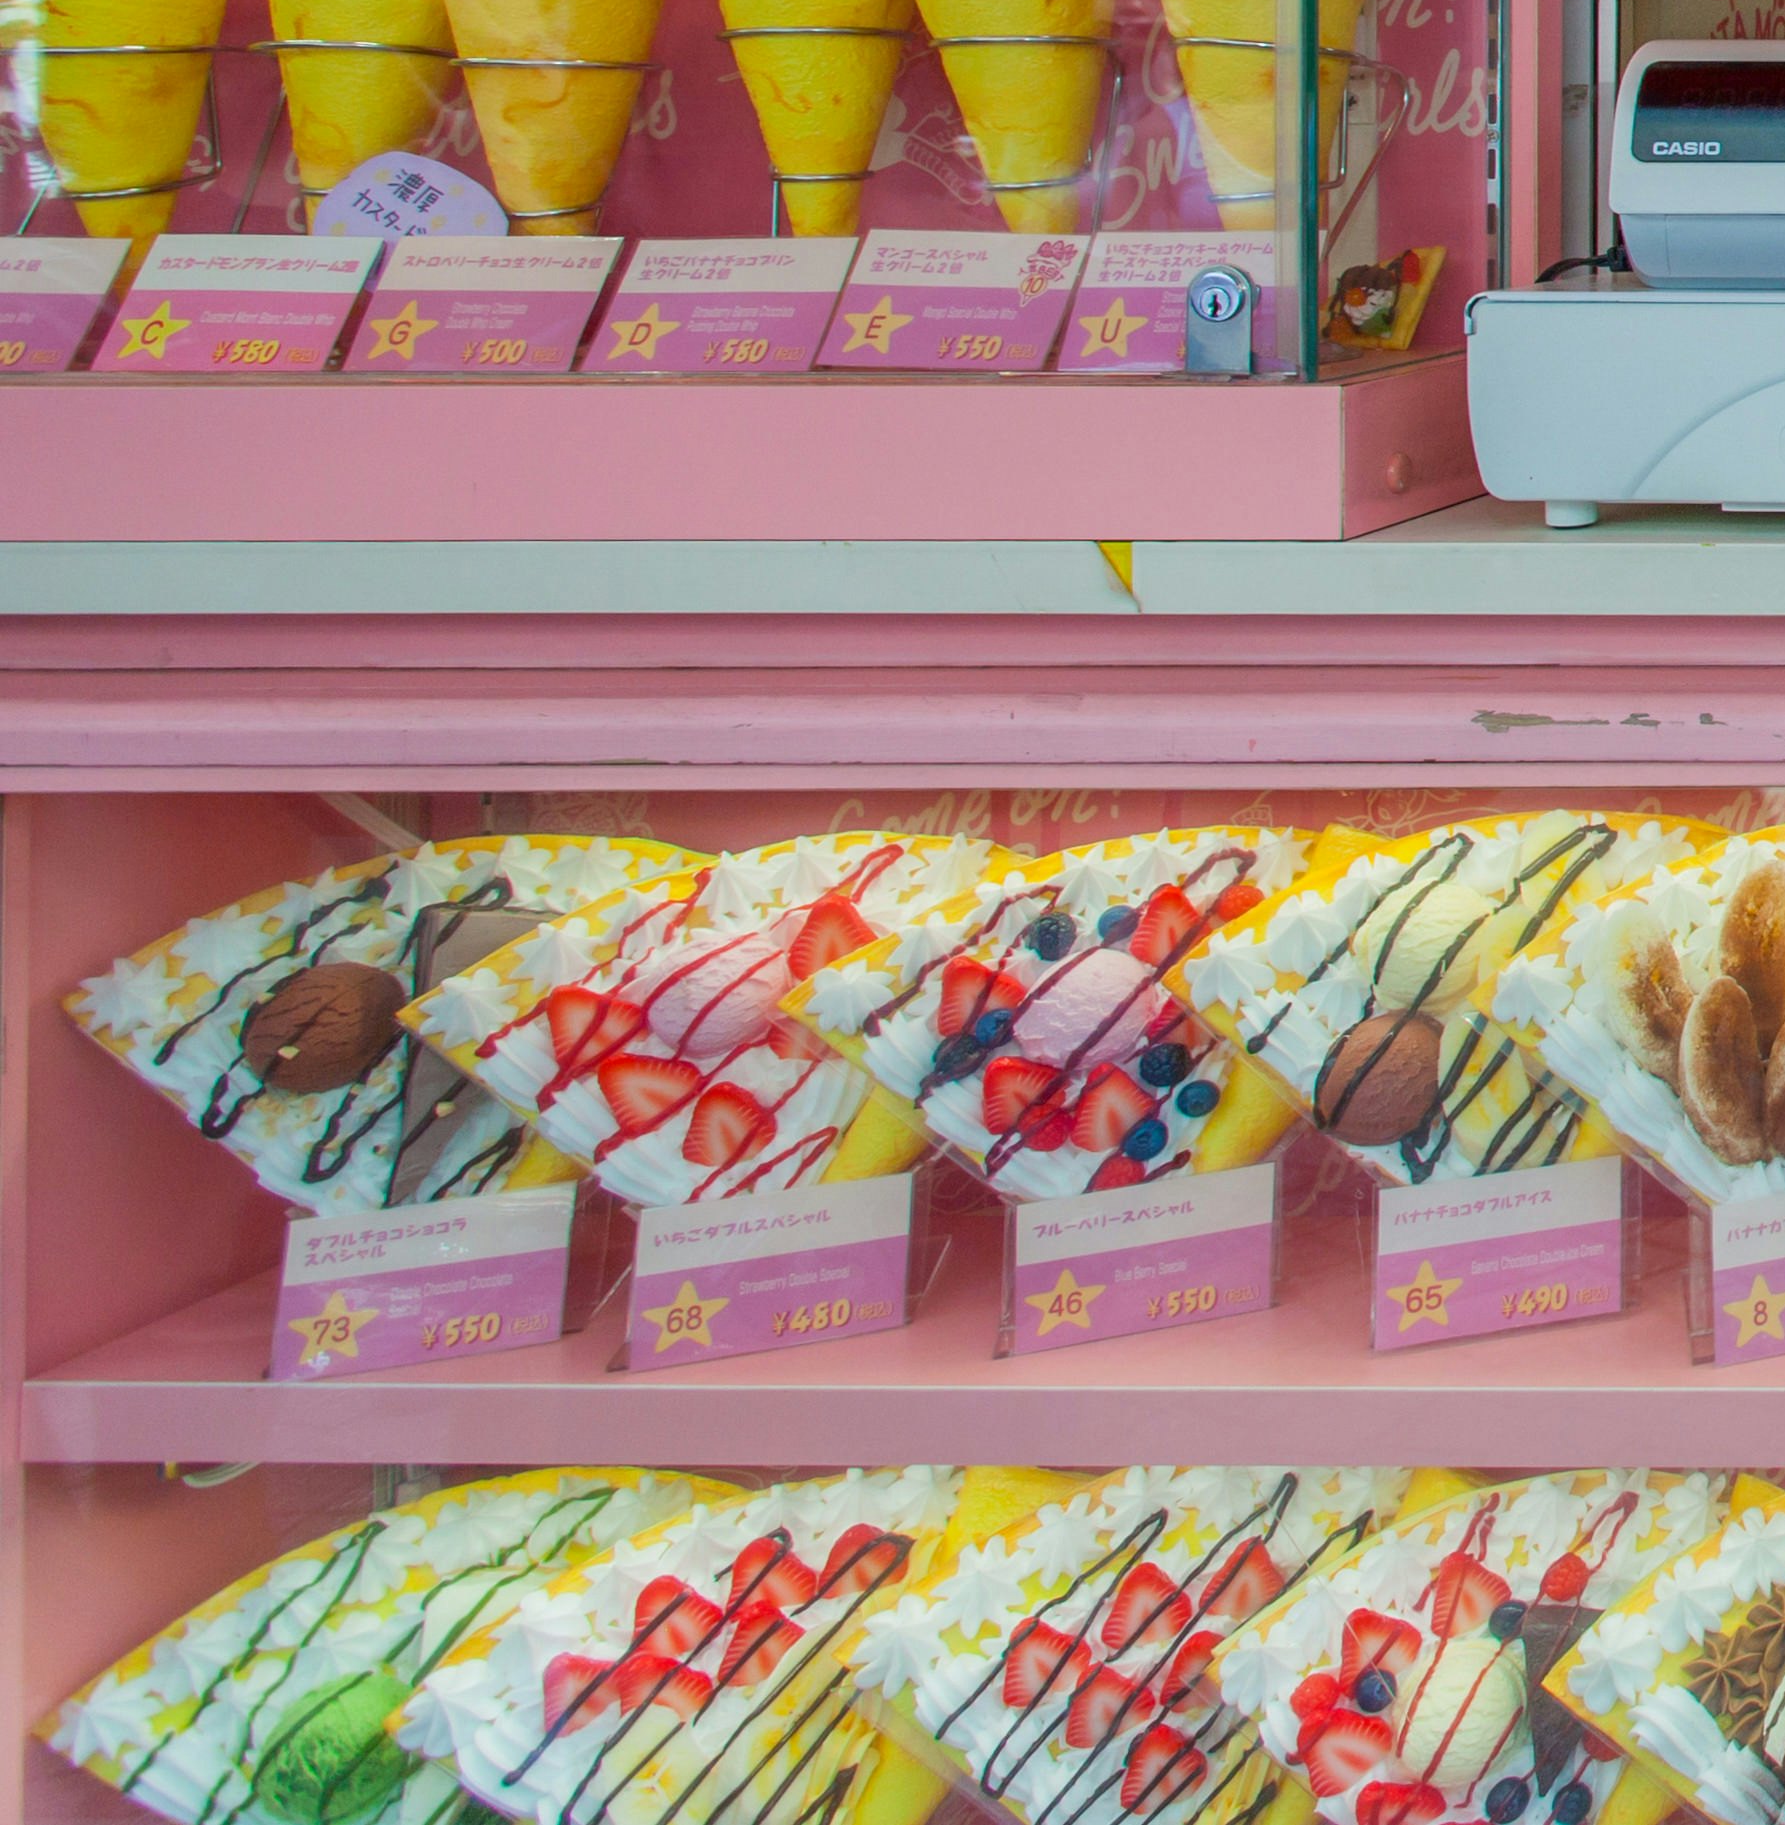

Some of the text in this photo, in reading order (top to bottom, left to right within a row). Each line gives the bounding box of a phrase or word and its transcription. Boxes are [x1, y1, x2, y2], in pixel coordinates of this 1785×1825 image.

[1652, 142, 1720, 155] CASIO
[387, 168, 444, 213] 濃厚
[876, 247, 989, 261] マンゴースペシャル
[141, 320, 164, 344] C
[388, 321, 412, 346] G
[628, 323, 652, 346] D
[864, 315, 886, 340] E
[212, 340, 280, 365] ¥580
[460, 339, 528, 365] ¥500
[703, 339, 769, 365] ¥580
[938, 335, 1003, 360] ¥550
[1033, 1200, 1195, 1239] ブルーベリースペシャル
[1394, 1190, 1552, 1226] バナナチョコダブルアイス
[306, 1217, 467, 1251] ダブルチョコショコラ
[654, 1209, 832, 1248] いちごダブルスペシャル
[305, 1245, 386, 1267] スペシャル
[1049, 1291, 1083, 1318] 46
[1147, 1285, 1216, 1320] ¥550
[1406, 1284, 1443, 1313] 65
[1502, 1283, 1568, 1319] ¥490
[667, 1305, 703, 1334] 68
[772, 1298, 851, 1336] ¥480
[1754, 1300, 1768, 1326] 8
[313, 1316, 351, 1346] 73
[421, 1312, 502, 1349] ¥550
